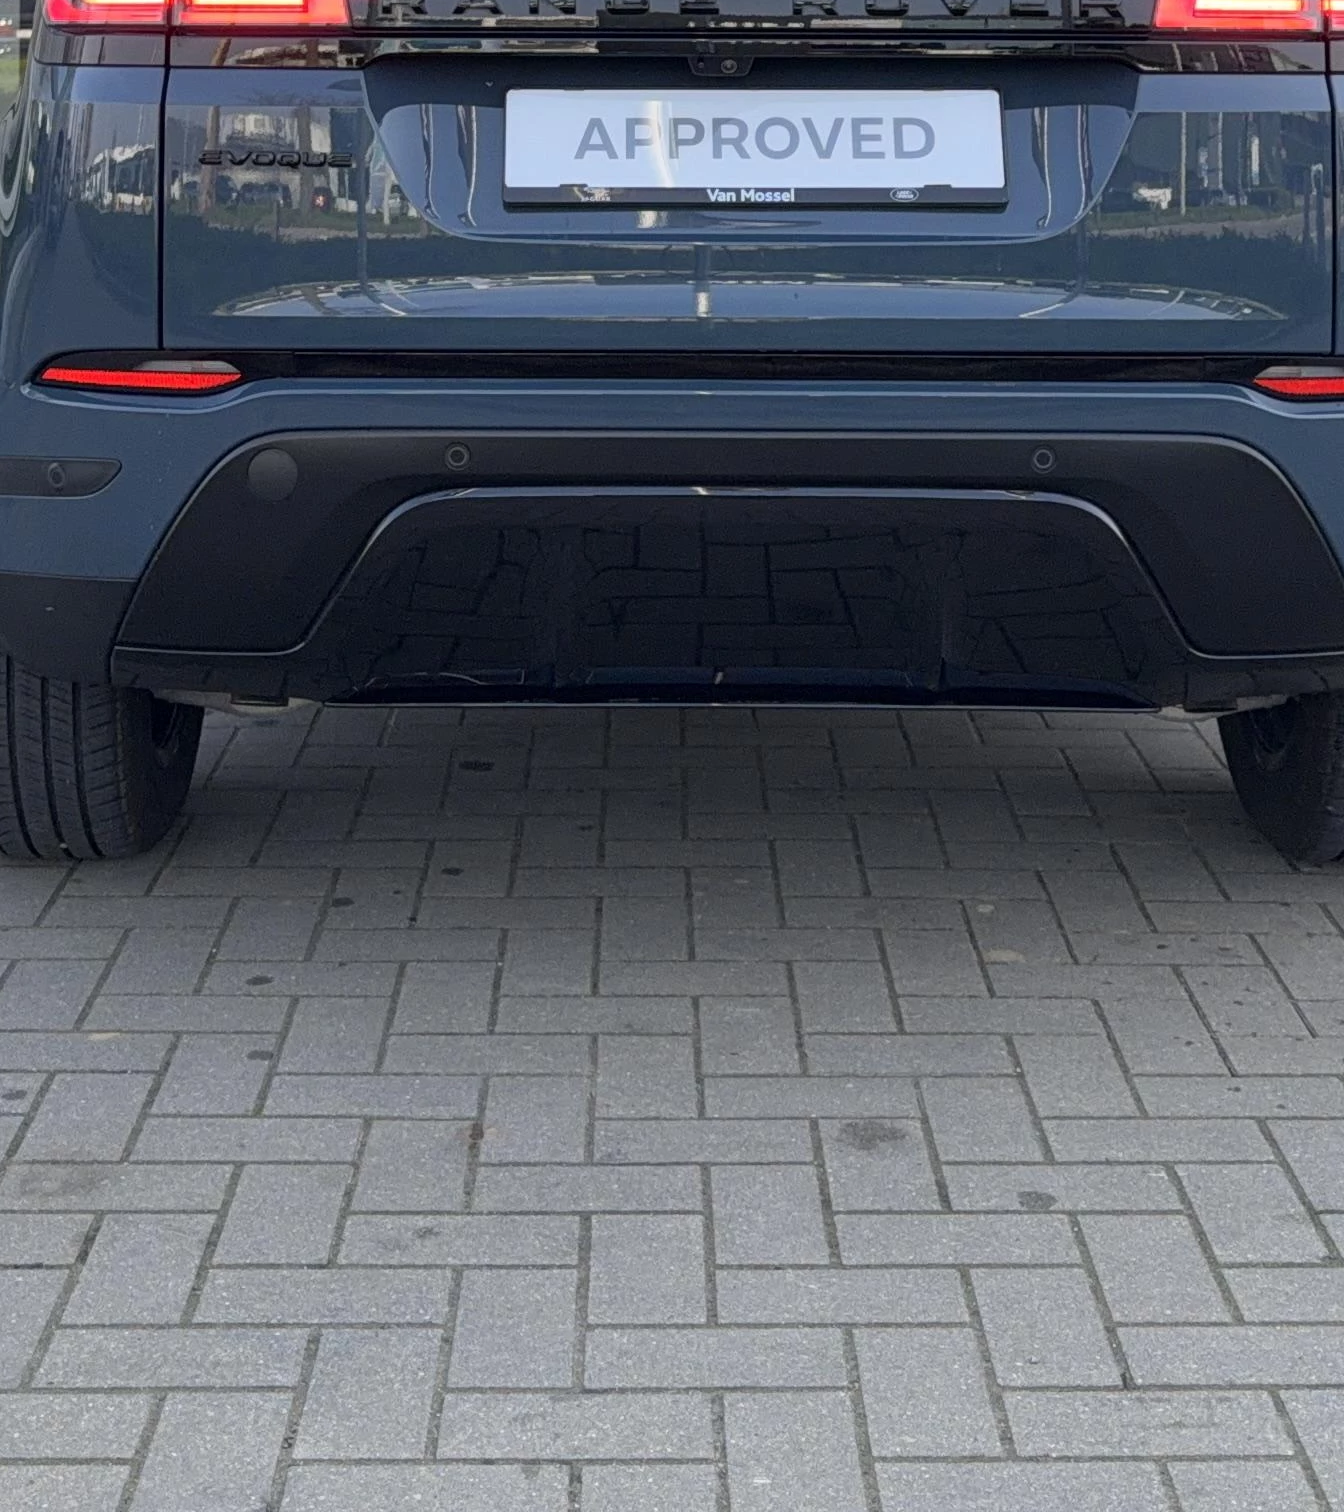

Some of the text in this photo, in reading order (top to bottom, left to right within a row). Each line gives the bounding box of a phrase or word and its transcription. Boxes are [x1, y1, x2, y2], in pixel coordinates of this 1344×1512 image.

[573, 116, 936, 160] APPROVED
[198, 149, 353, 169] EVOQUE
[706, 188, 795, 202] Van Mossel
